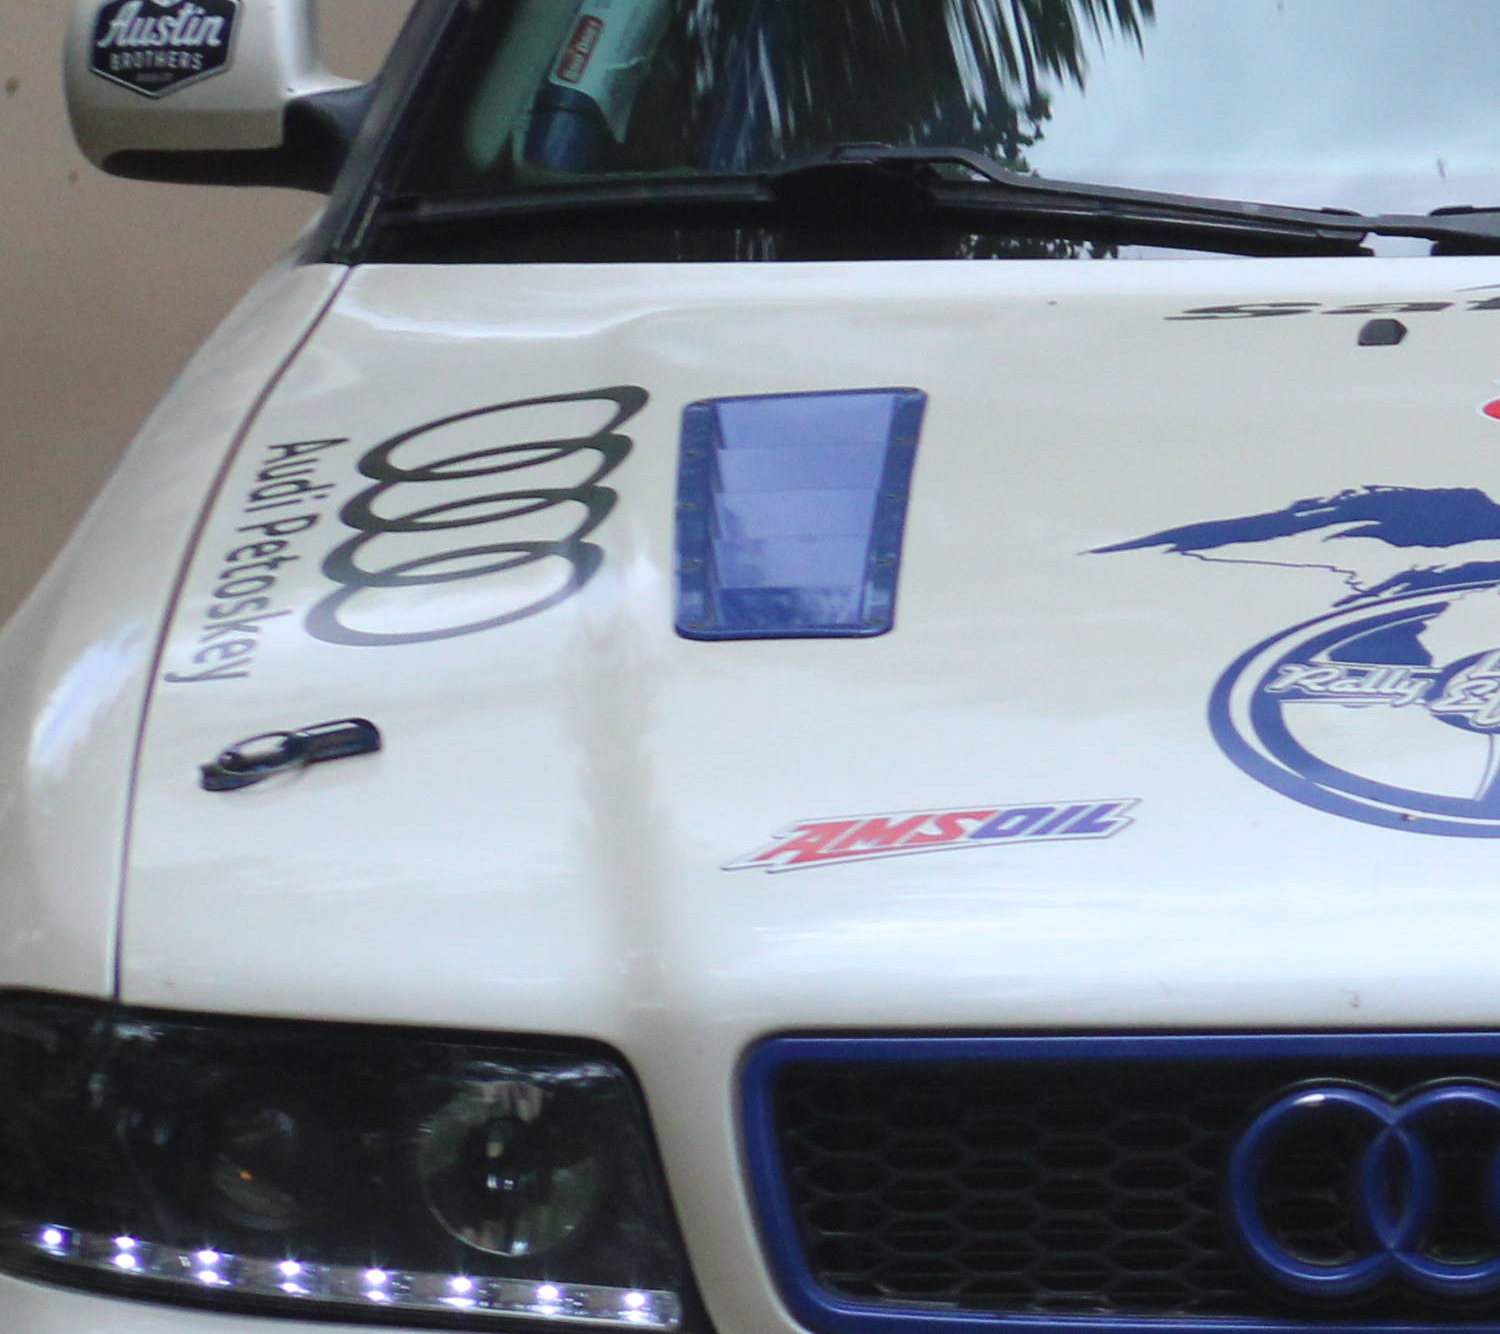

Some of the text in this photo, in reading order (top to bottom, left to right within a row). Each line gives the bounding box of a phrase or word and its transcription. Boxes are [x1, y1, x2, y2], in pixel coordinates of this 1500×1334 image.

[96, 0, 225, 48] Austin
[109, 49, 204, 71] BROTHERS
[163, 437, 350, 684] Audi Petoskey
[1264, 664, 1437, 707] Rally
[750, 802, 1123, 866] AMSOIL
